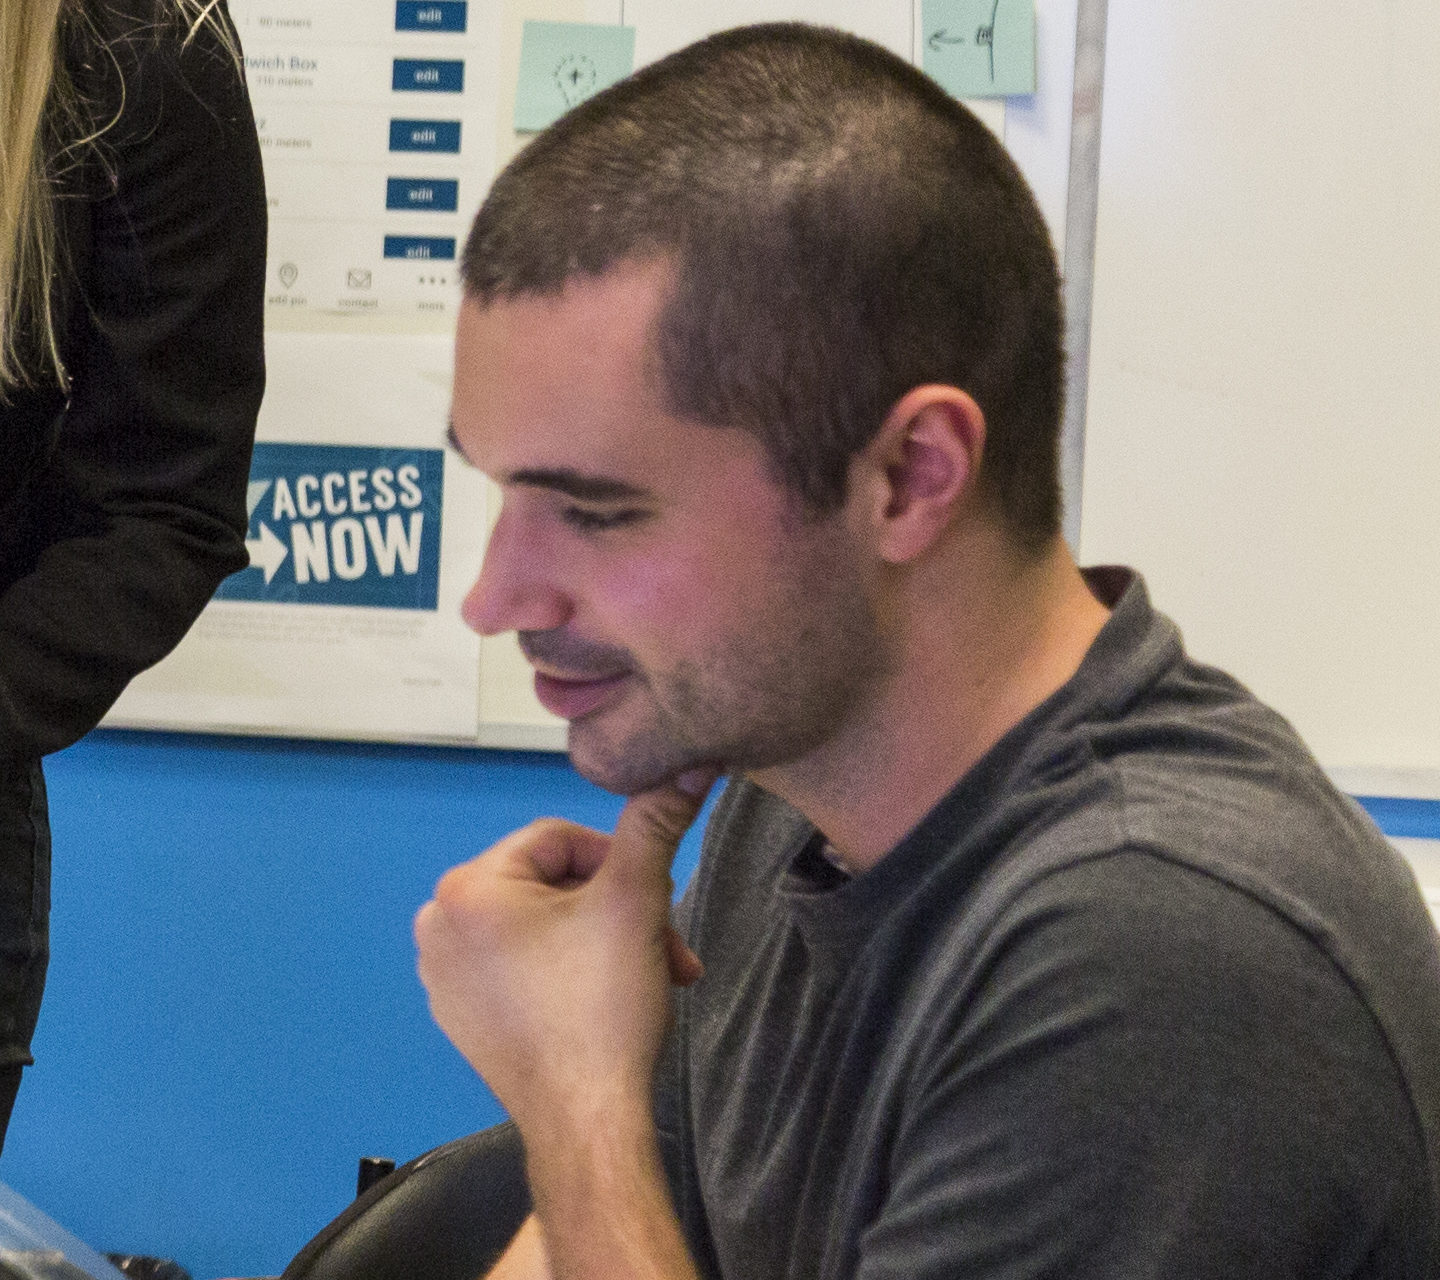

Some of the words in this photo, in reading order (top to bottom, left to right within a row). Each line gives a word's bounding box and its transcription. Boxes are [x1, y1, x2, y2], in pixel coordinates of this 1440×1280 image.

[417, 9, 442, 22] edit
[289, 57, 318, 71] Box
[415, 69, 439, 83] edit
[412, 129, 437, 143] edit
[410, 189, 433, 202] edit
[406, 247, 430, 258] edit
[272, 465, 423, 521] ACCESS
[290, 511, 424, 584] NOW
